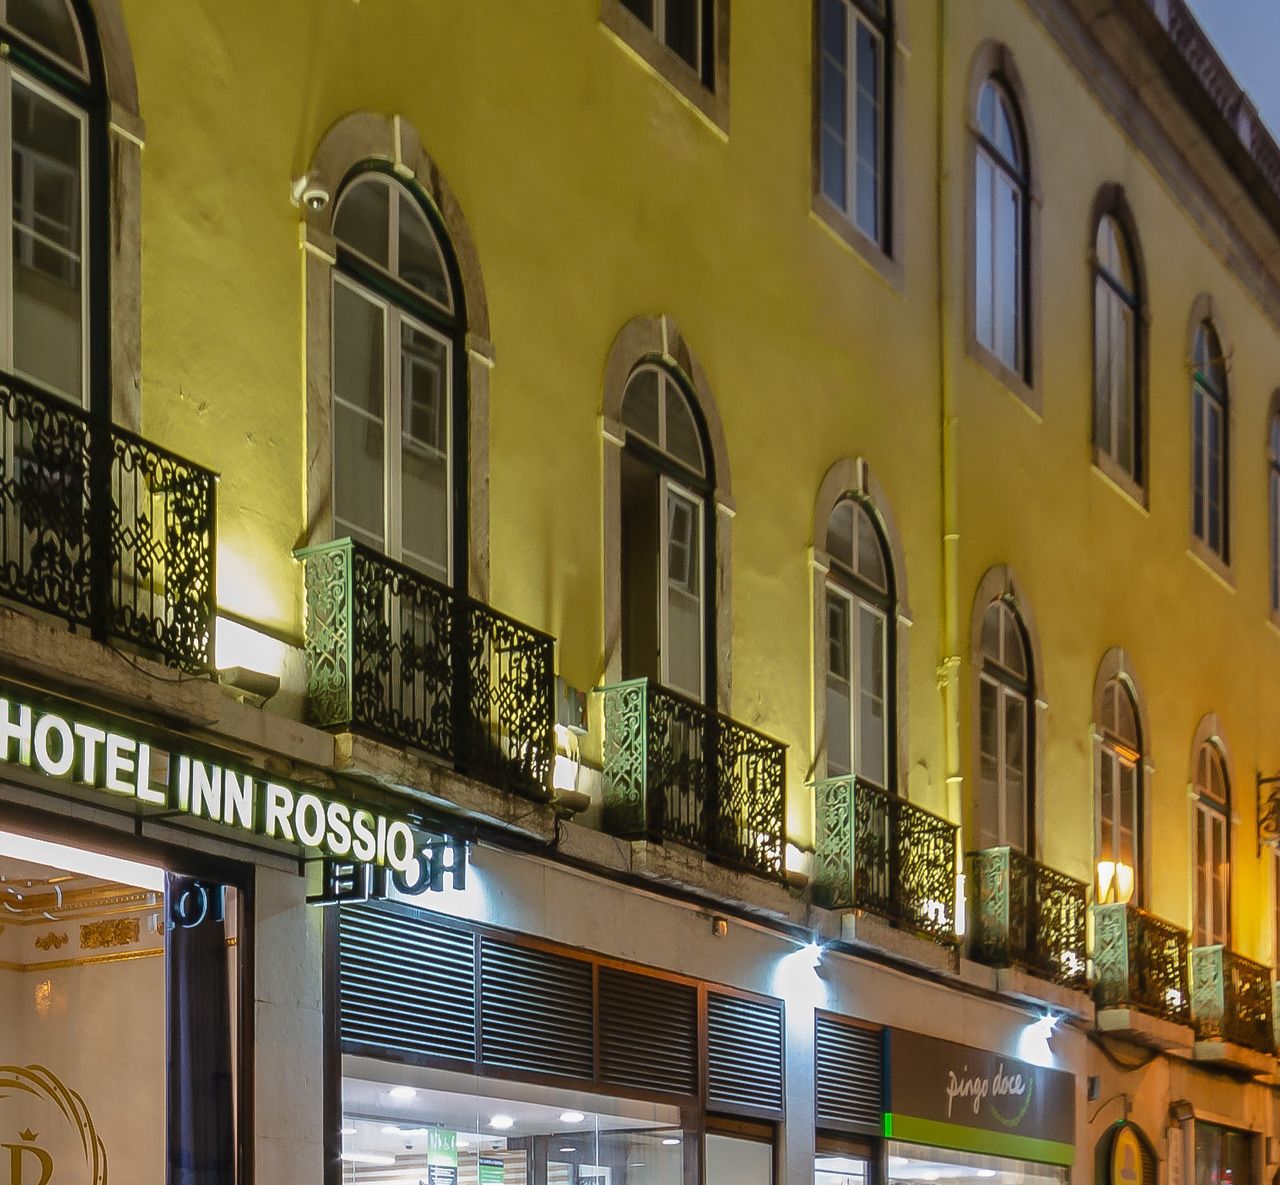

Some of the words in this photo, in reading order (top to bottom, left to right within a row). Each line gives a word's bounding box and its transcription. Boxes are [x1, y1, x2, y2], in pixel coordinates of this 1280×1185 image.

[179, 754, 253, 830] INN
[266, 781, 415, 872] ROSSIO
[946, 1064, 989, 1119] pingo
[992, 1062, 1026, 1096] doce
